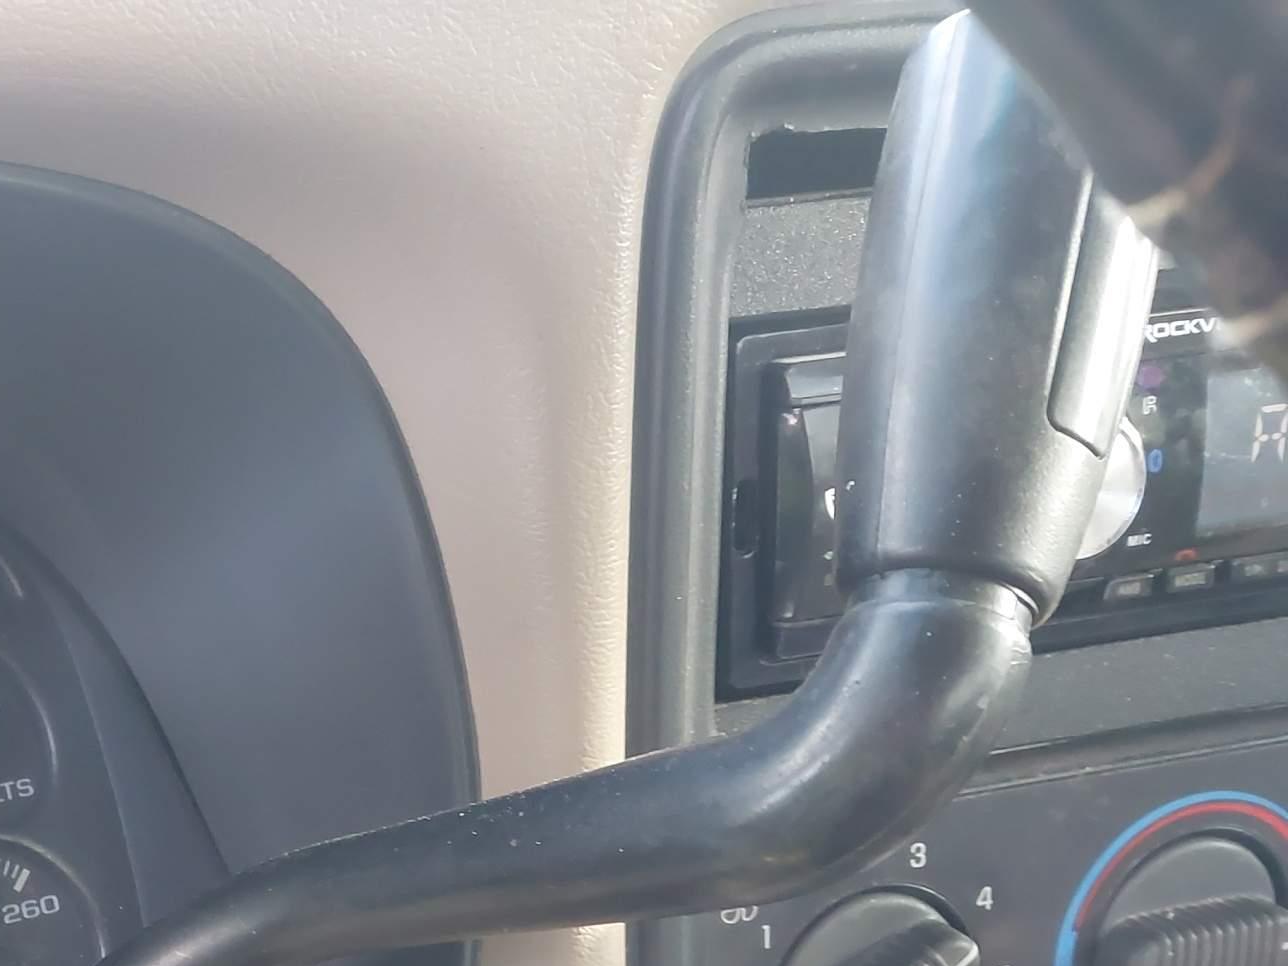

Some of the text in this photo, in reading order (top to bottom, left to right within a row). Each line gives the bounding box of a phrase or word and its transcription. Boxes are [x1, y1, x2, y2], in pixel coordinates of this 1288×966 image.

[911, 842, 928, 868] 3
[2, 894, 60, 924] 260
[976, 887, 994, 910] 4
[762, 925, 770, 949] 1
